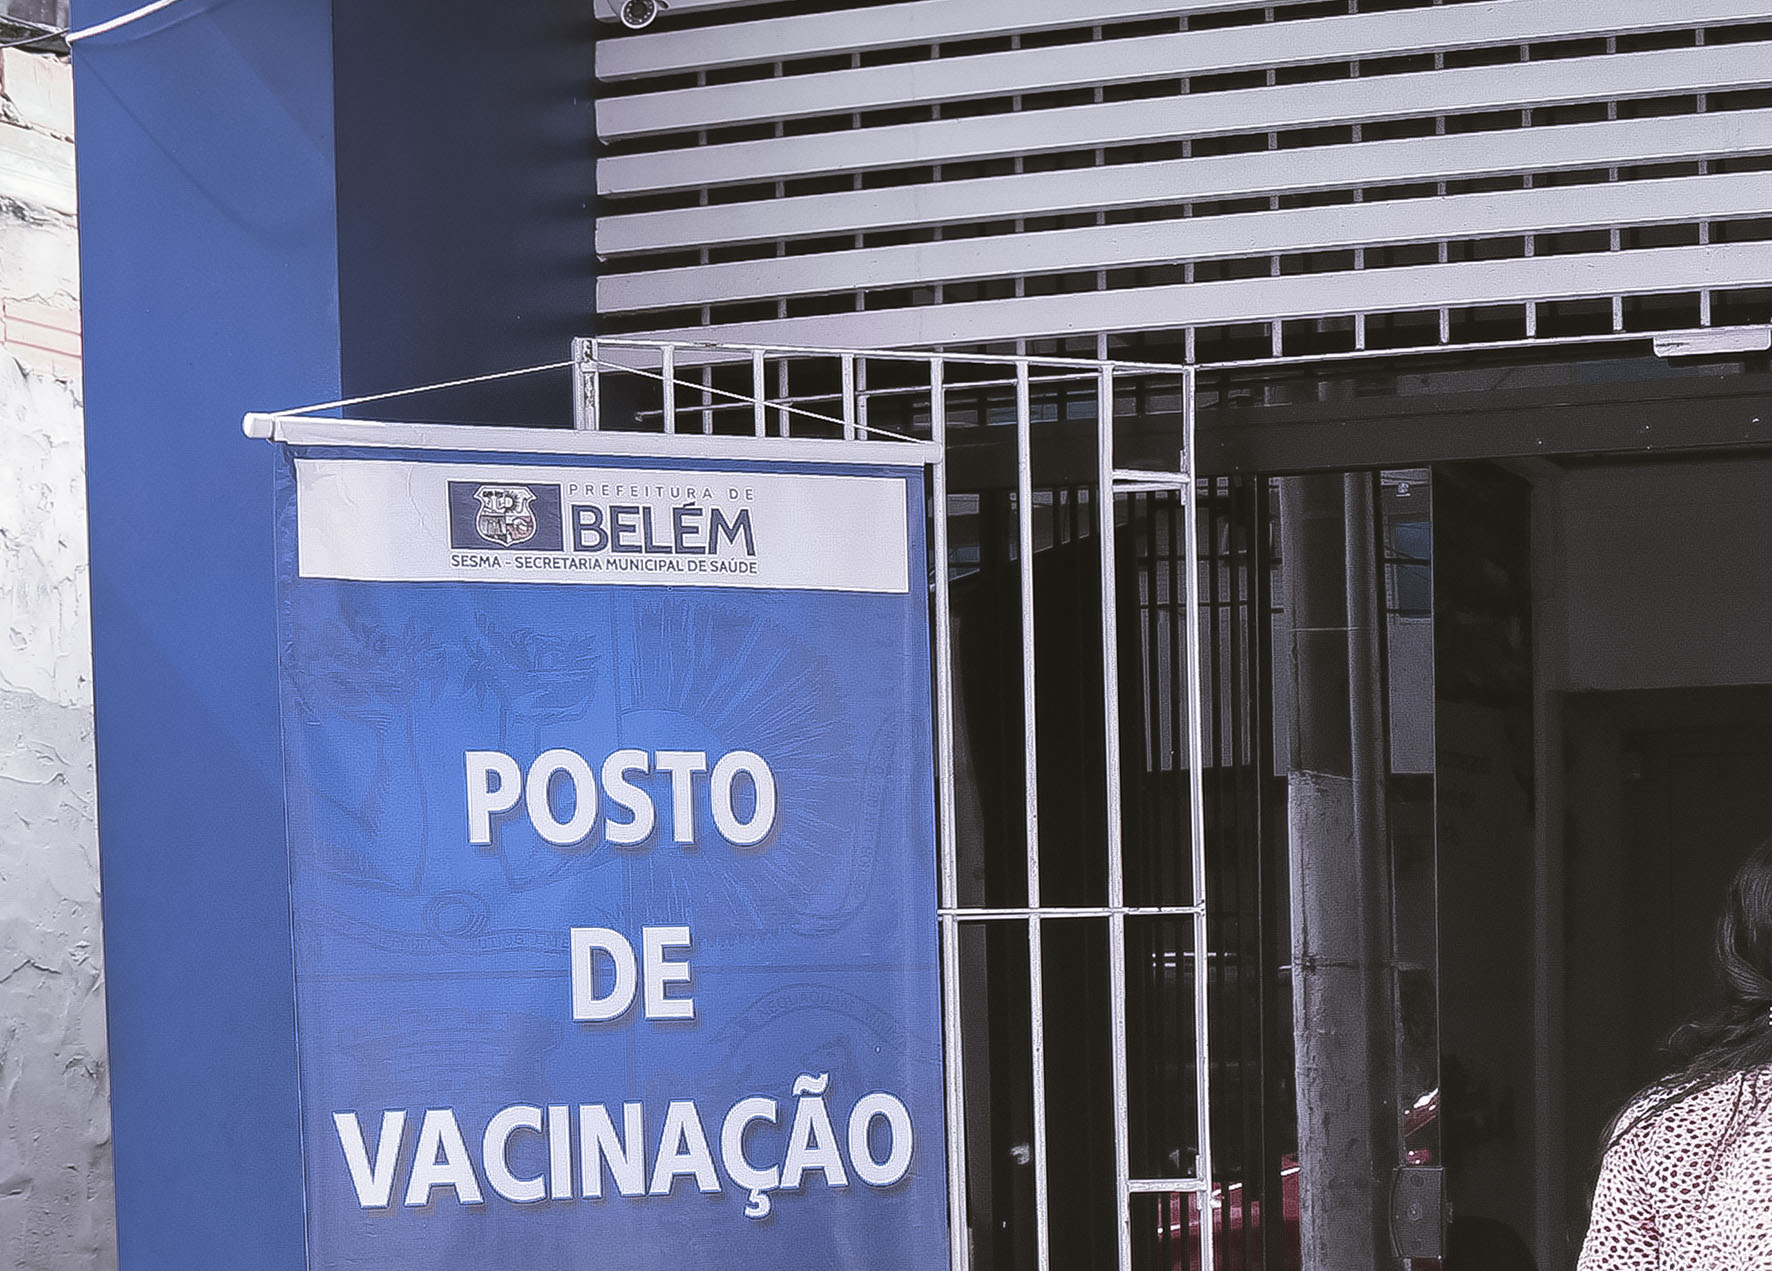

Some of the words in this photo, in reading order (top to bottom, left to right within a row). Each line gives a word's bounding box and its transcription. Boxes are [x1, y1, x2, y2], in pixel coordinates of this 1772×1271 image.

[569, 484, 713, 499] PREFEITURA
[729, 488, 755, 500] DE
[571, 501, 756, 556] BELÉM
[451, 554, 501, 568] SESMA
[515, 556, 601, 571] SECRETARIA
[605, 558, 685, 572] MUNICIPAL
[688, 560, 707, 572] DE
[710, 557, 758, 573] SAÚDE
[464, 748, 778, 845] POSTO
[570, 925, 695, 1021] DE
[332, 1073, 914, 1217] VACINAÇÃO
